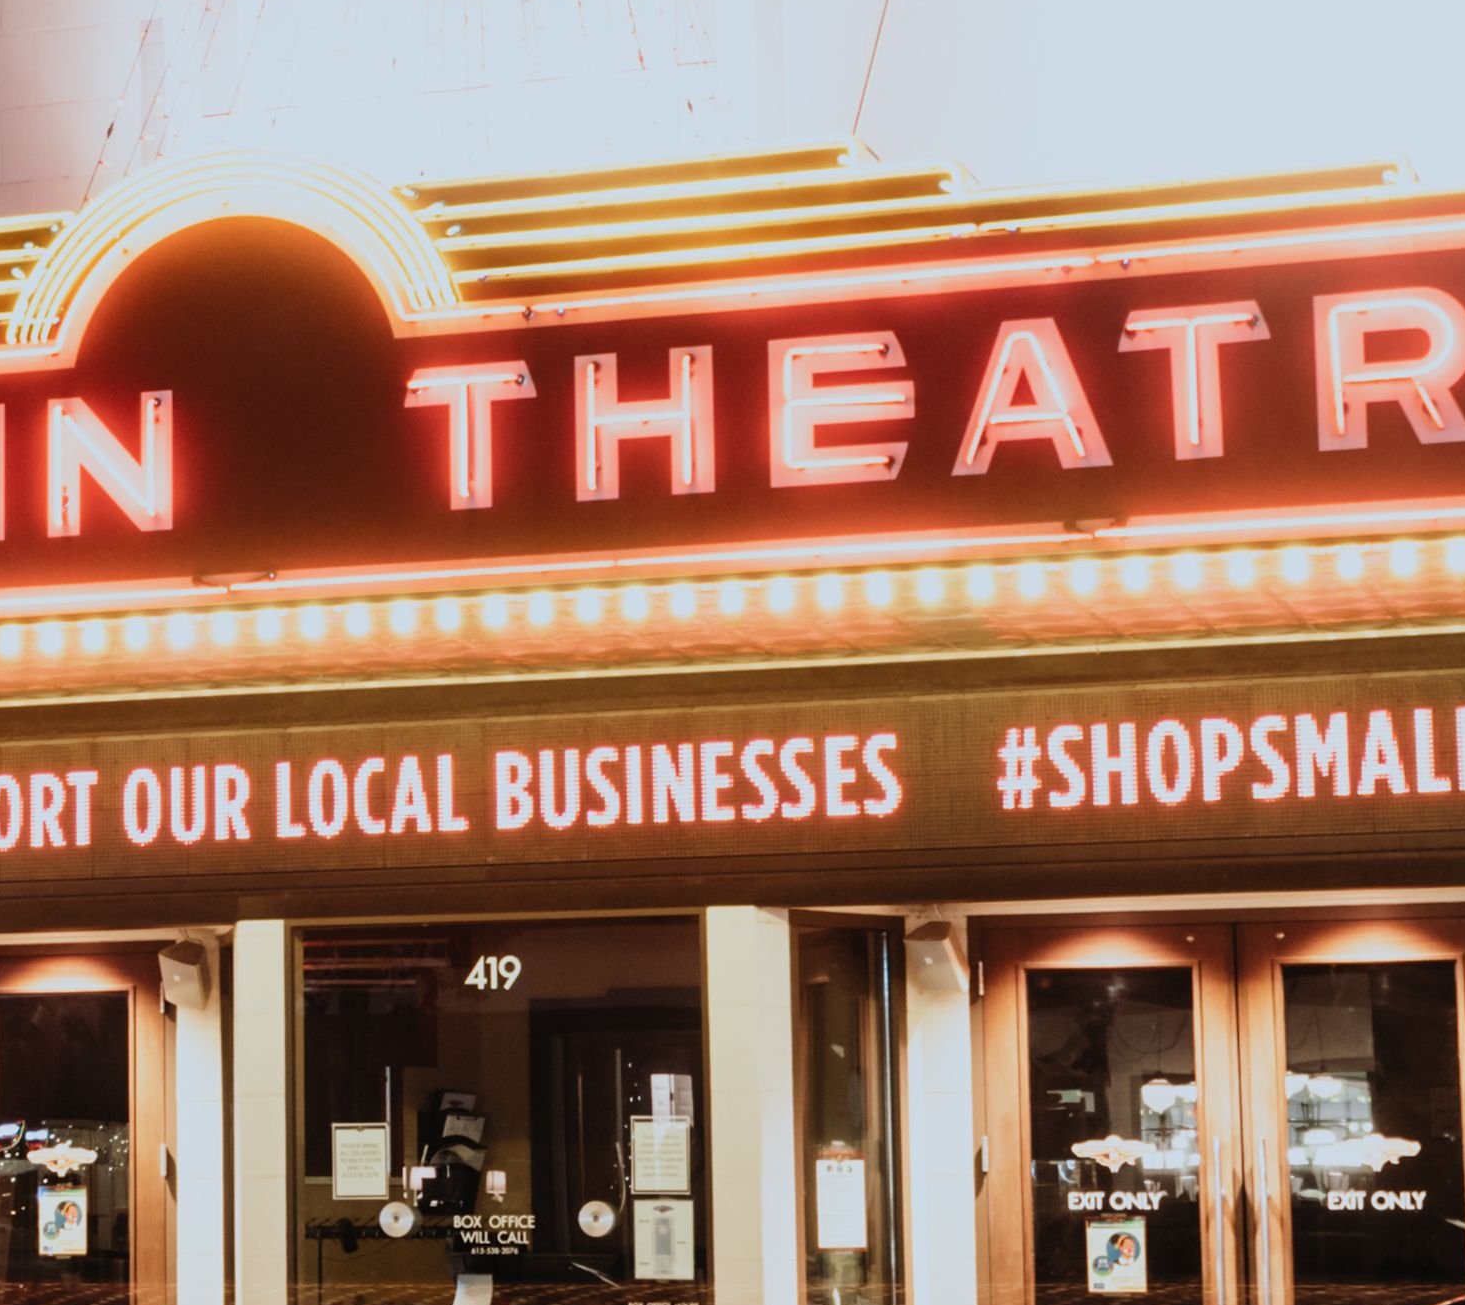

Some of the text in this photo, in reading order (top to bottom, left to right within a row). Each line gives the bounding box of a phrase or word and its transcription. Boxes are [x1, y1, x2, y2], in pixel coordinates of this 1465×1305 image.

[124, 764, 250, 846] OUR
[275, 753, 469, 839] LOCAL
[495, 732, 903, 830] BUSINESSES
[464, 955, 522, 990] 419
[1068, 1191, 1163, 1211] EXIT ONLY
[1327, 1190, 1427, 1211] EXIT ONLY
[453, 1214, 536, 1229] BOX OFFICE
[460, 1230, 529, 1245] WILL CALL
